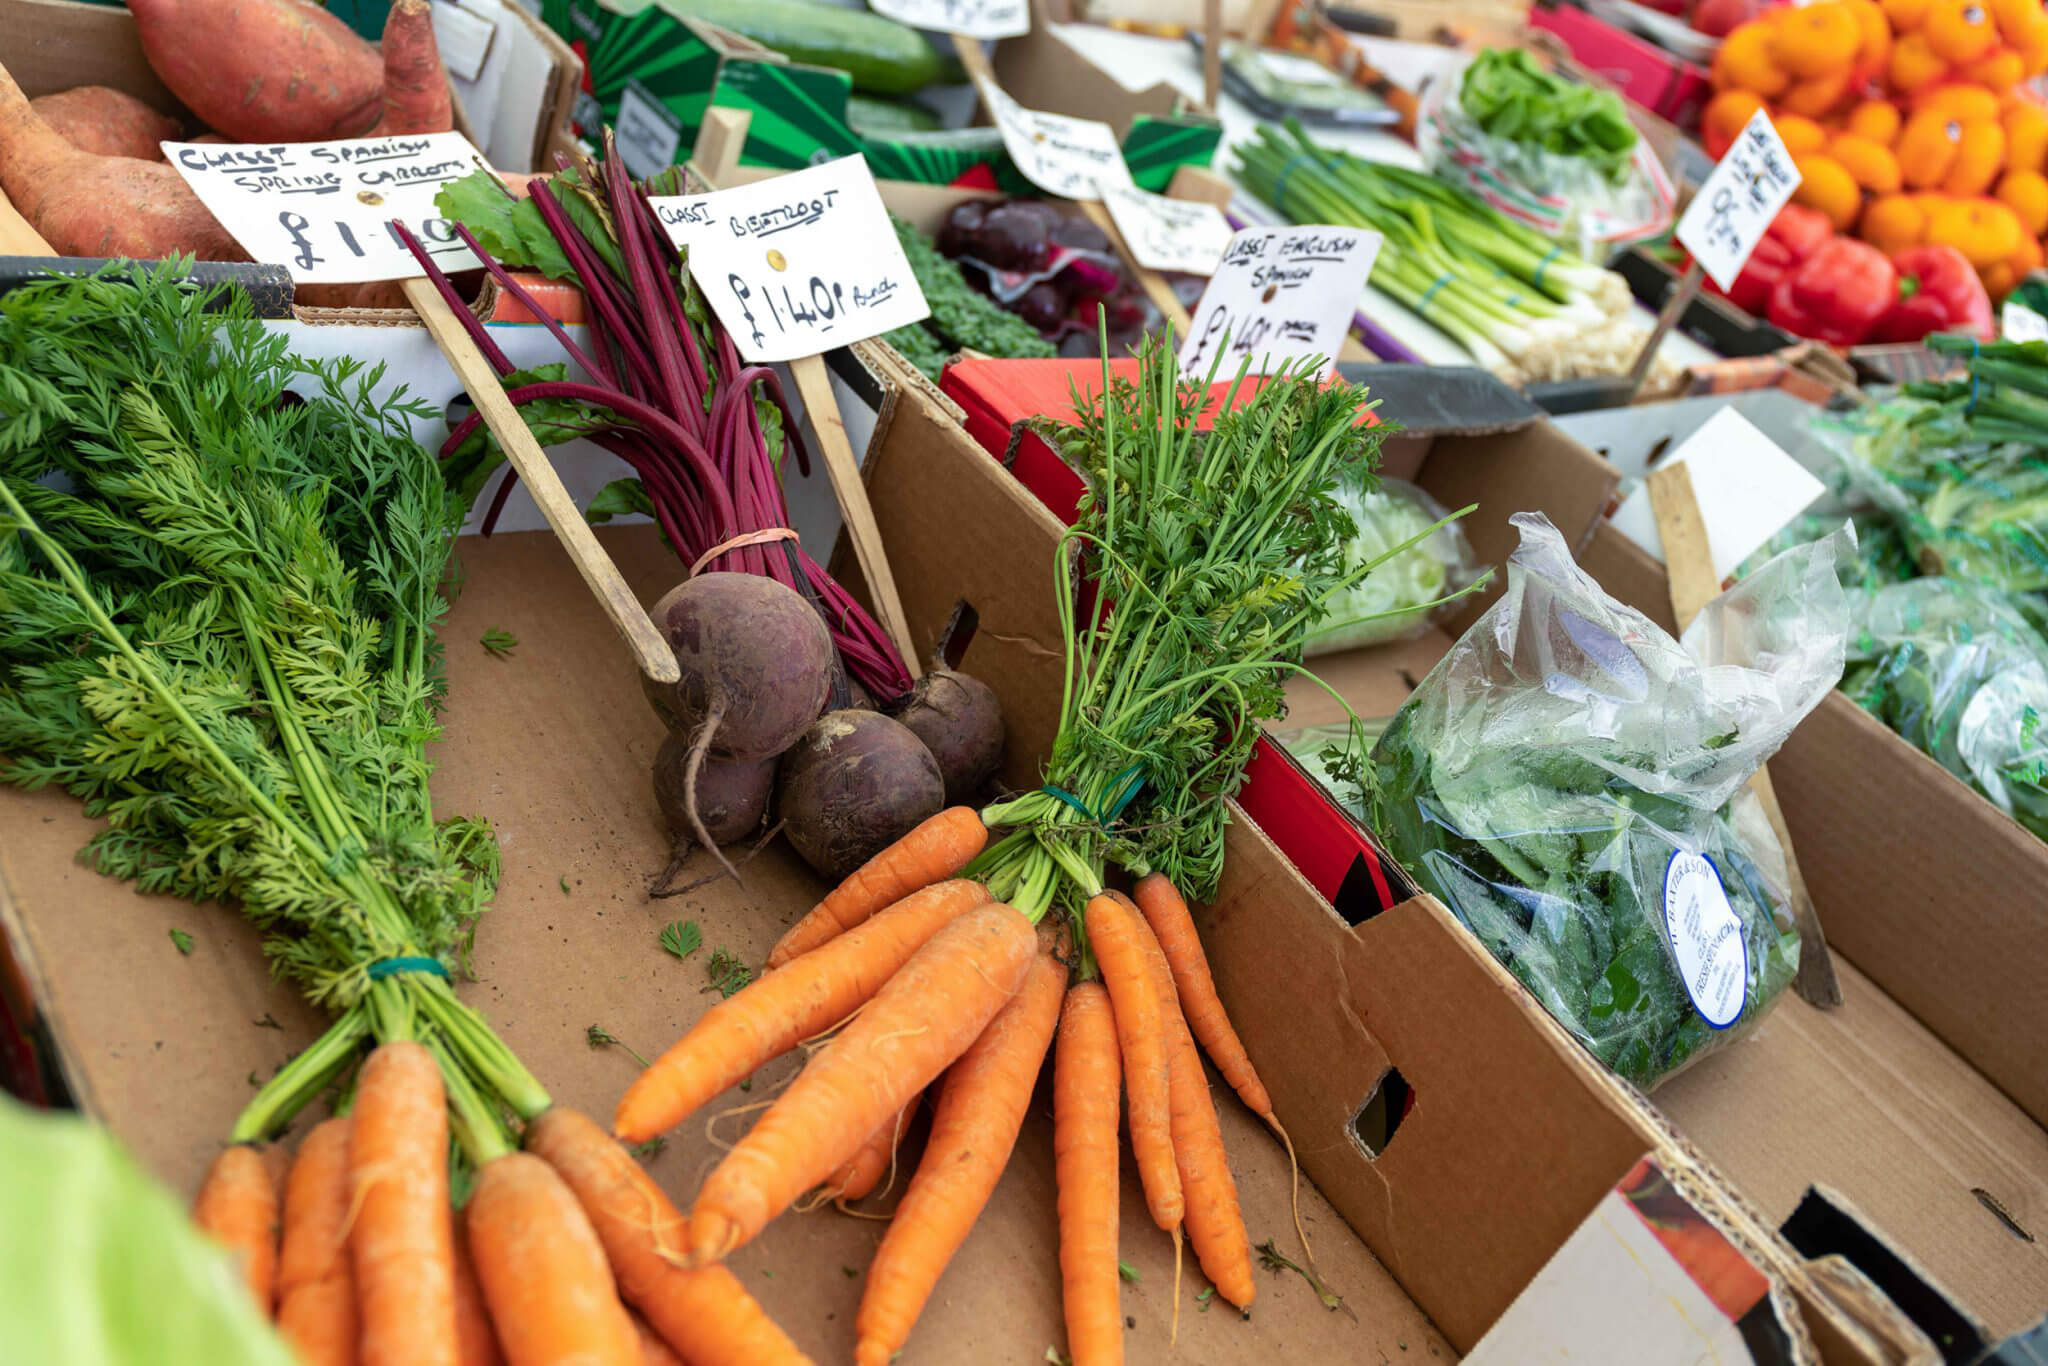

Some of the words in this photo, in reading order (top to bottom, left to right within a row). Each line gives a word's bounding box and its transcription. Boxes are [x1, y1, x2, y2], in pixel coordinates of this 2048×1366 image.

[234, 172, 342, 192] SPRING
[358, 160, 465, 184] CARROTS
[730, 190, 839, 237] BEETROOT
